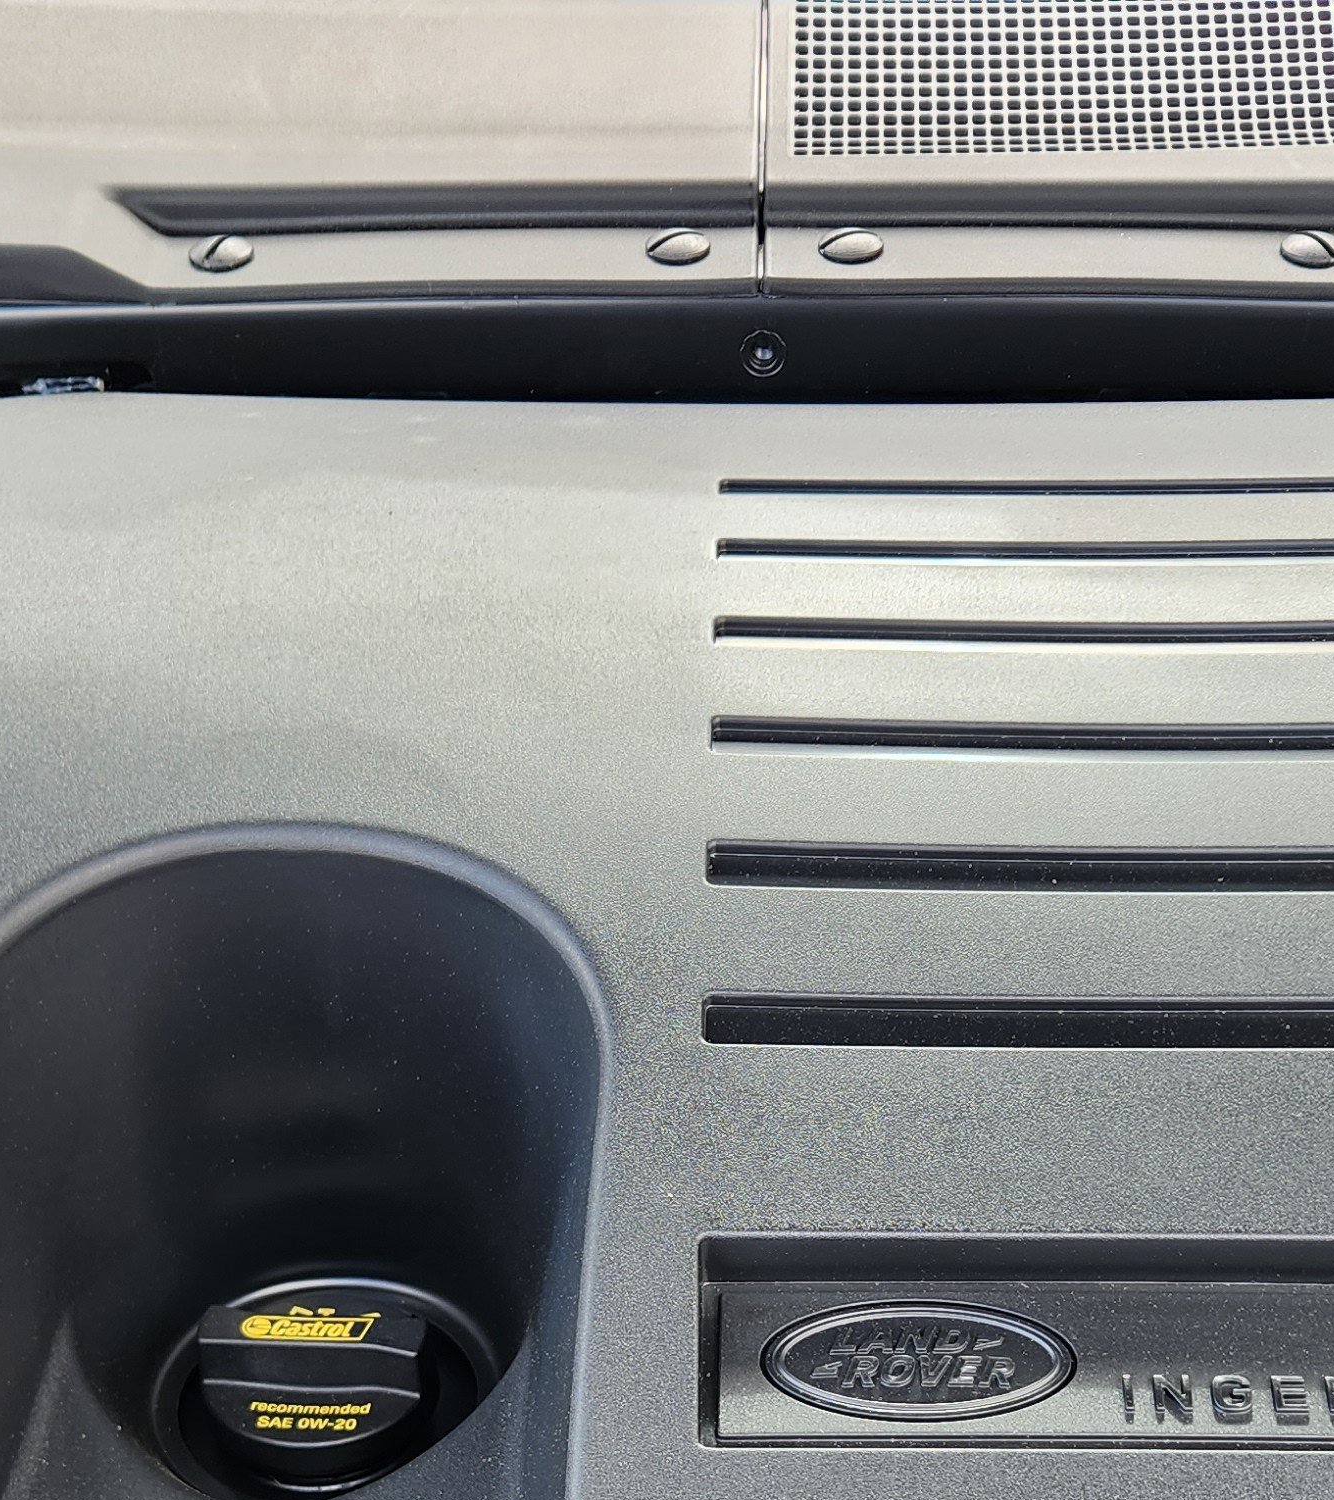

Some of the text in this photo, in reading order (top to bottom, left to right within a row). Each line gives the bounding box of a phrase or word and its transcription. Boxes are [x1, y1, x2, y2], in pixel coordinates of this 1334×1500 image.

[270, 1318, 353, 1338] Castrol
[829, 1326, 969, 1356] LAND
[841, 1354, 1016, 1390] ROVER
[250, 1401, 372, 1416] recommended
[256, 1416, 358, 1432] SAE 0W-20
